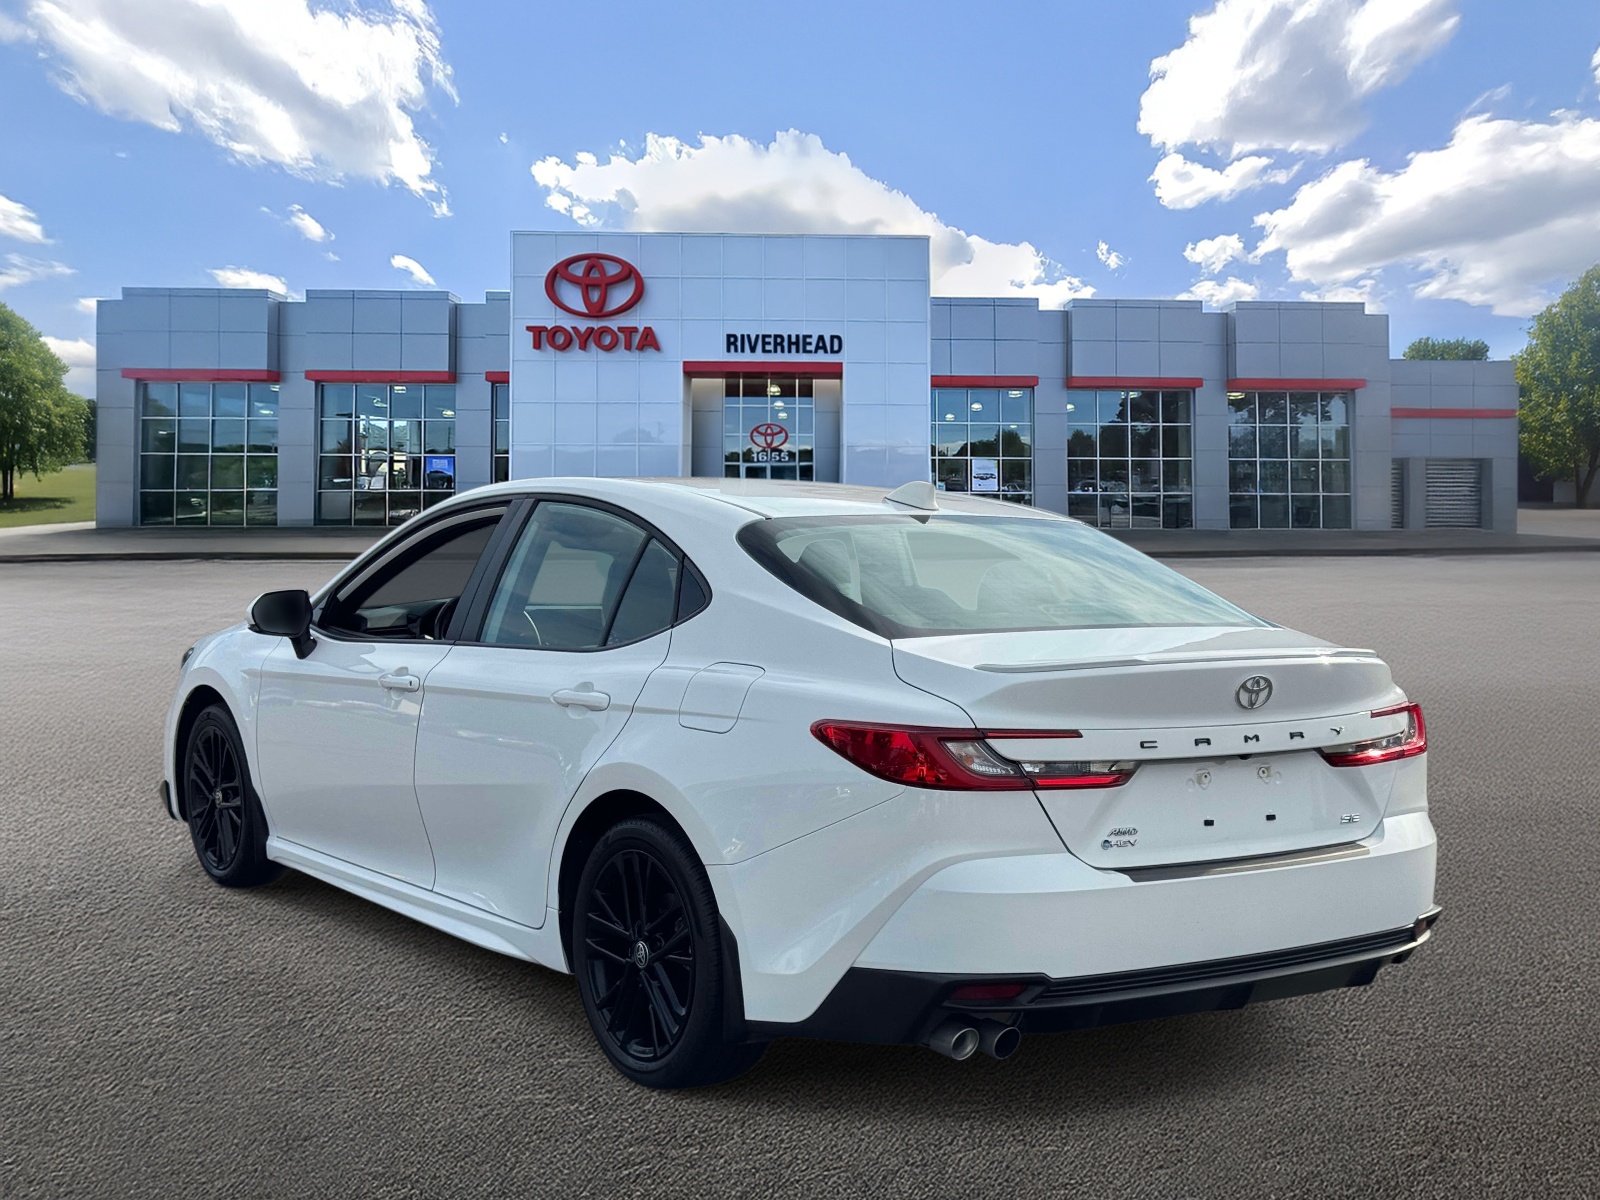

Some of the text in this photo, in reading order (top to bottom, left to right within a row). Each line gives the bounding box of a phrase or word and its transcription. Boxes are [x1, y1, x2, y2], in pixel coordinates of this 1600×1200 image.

[526, 325, 661, 352] TOYOTA
[726, 333, 843, 355] RIVERHEAD
[1139, 726, 1345, 750] CAMRY
[1340, 813, 1360, 824] SE
[1107, 827, 1138, 837] AWD
